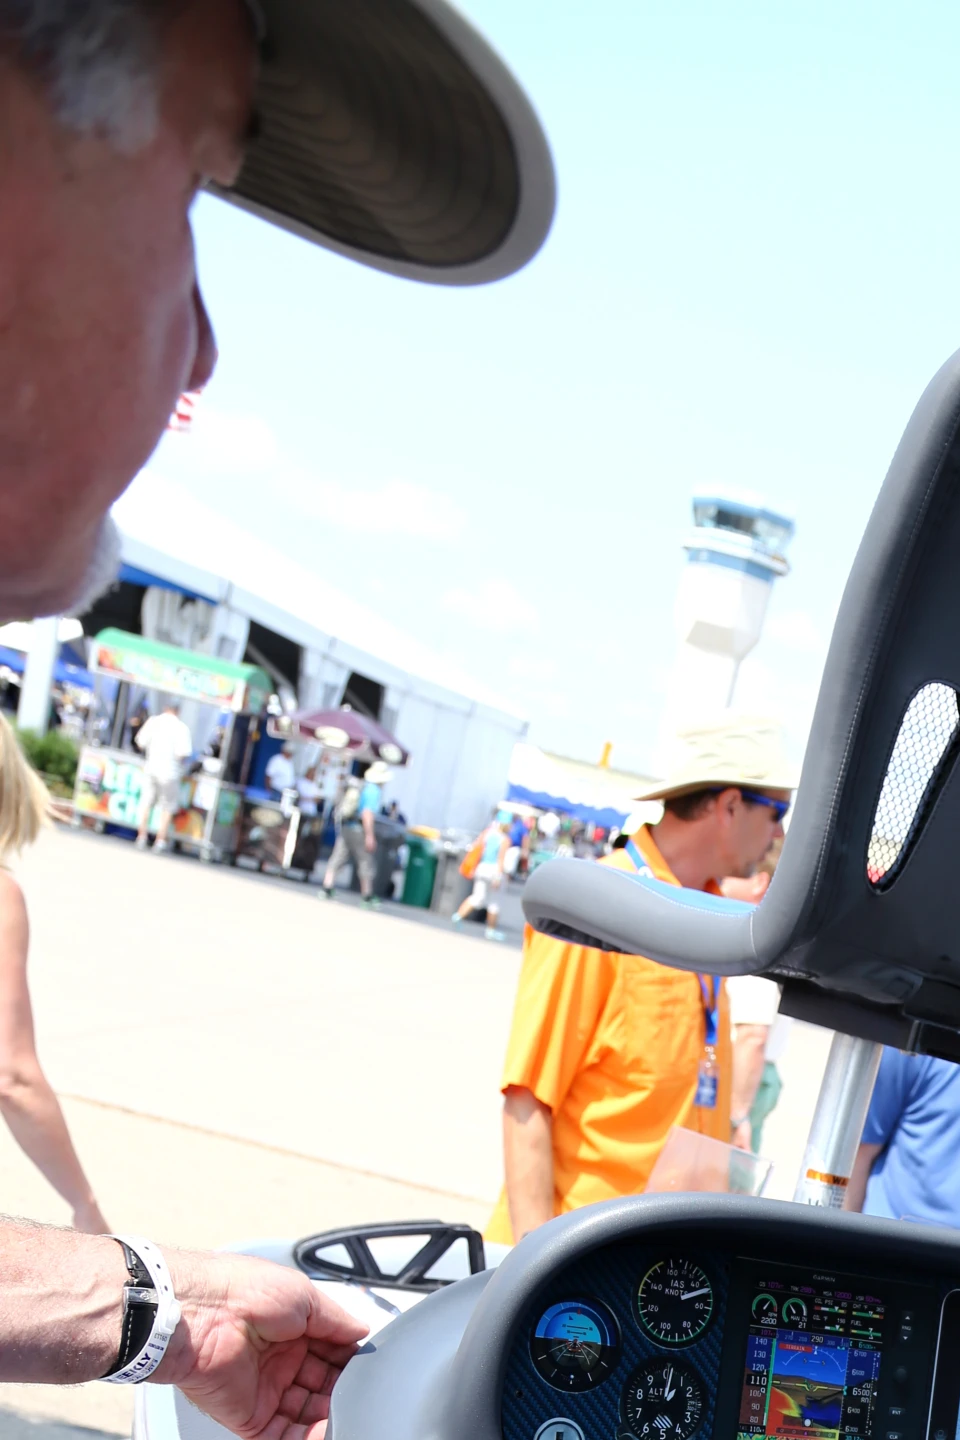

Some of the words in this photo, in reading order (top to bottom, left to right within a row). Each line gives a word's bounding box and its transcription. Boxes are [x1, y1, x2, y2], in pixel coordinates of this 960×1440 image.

[812, 1274, 836, 1283] GARMIN
[670, 1280, 685, 1288] IAS
[648, 1304, 659, 1312] 120
[760, 1316, 777, 1325] 2200
[811, 1336, 824, 1344] 290
[754, 1350, 766, 1358] 130
[647, 1375, 654, 1386] 9
[750, 1376, 767, 1386] 110
[636, 1388, 643, 1400] 8
[648, 1388, 663, 1396] ALT
[686, 1386, 693, 1398] 2
[749, 1389, 761, 1397] 100
[852, 1388, 870, 1397] 6500
[751, 1402, 760, 1410] 90
[636, 1408, 642, 1419] 7
[684, 1412, 691, 1423] 3
[750, 1416, 759, 1424] 80
[642, 1422, 650, 1433] 6
[676, 1424, 682, 1434] 4
[660, 1428, 666, 1440] 5
